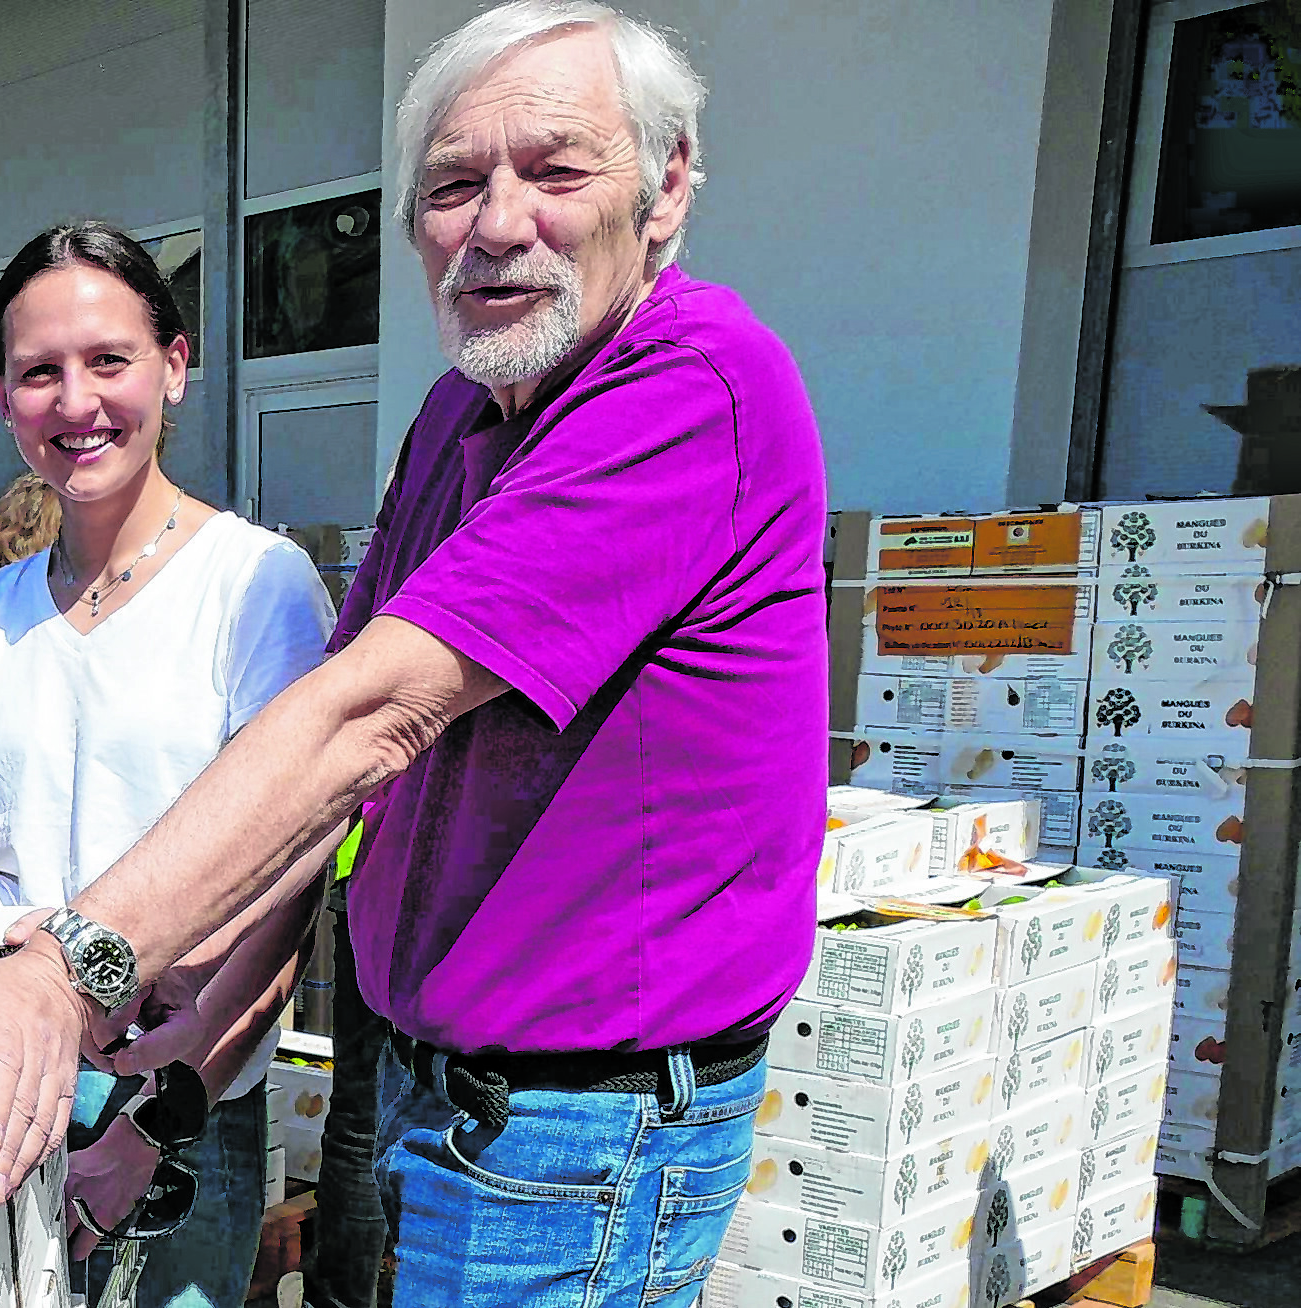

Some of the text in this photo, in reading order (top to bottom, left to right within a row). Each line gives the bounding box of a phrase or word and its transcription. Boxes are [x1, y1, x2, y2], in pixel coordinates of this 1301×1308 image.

[1176, 519, 1227, 529] MANGUES
[1193, 530, 1208, 539] DU
[1176, 542, 1222, 551] BURKINA
[1194, 585, 1210, 593] DU
[1173, 634, 1223, 642] MANGUES
[1161, 700, 1211, 709] MANGUES
[1177, 710, 1193, 718] DU
[1161, 721, 1206, 730] BURKINA
